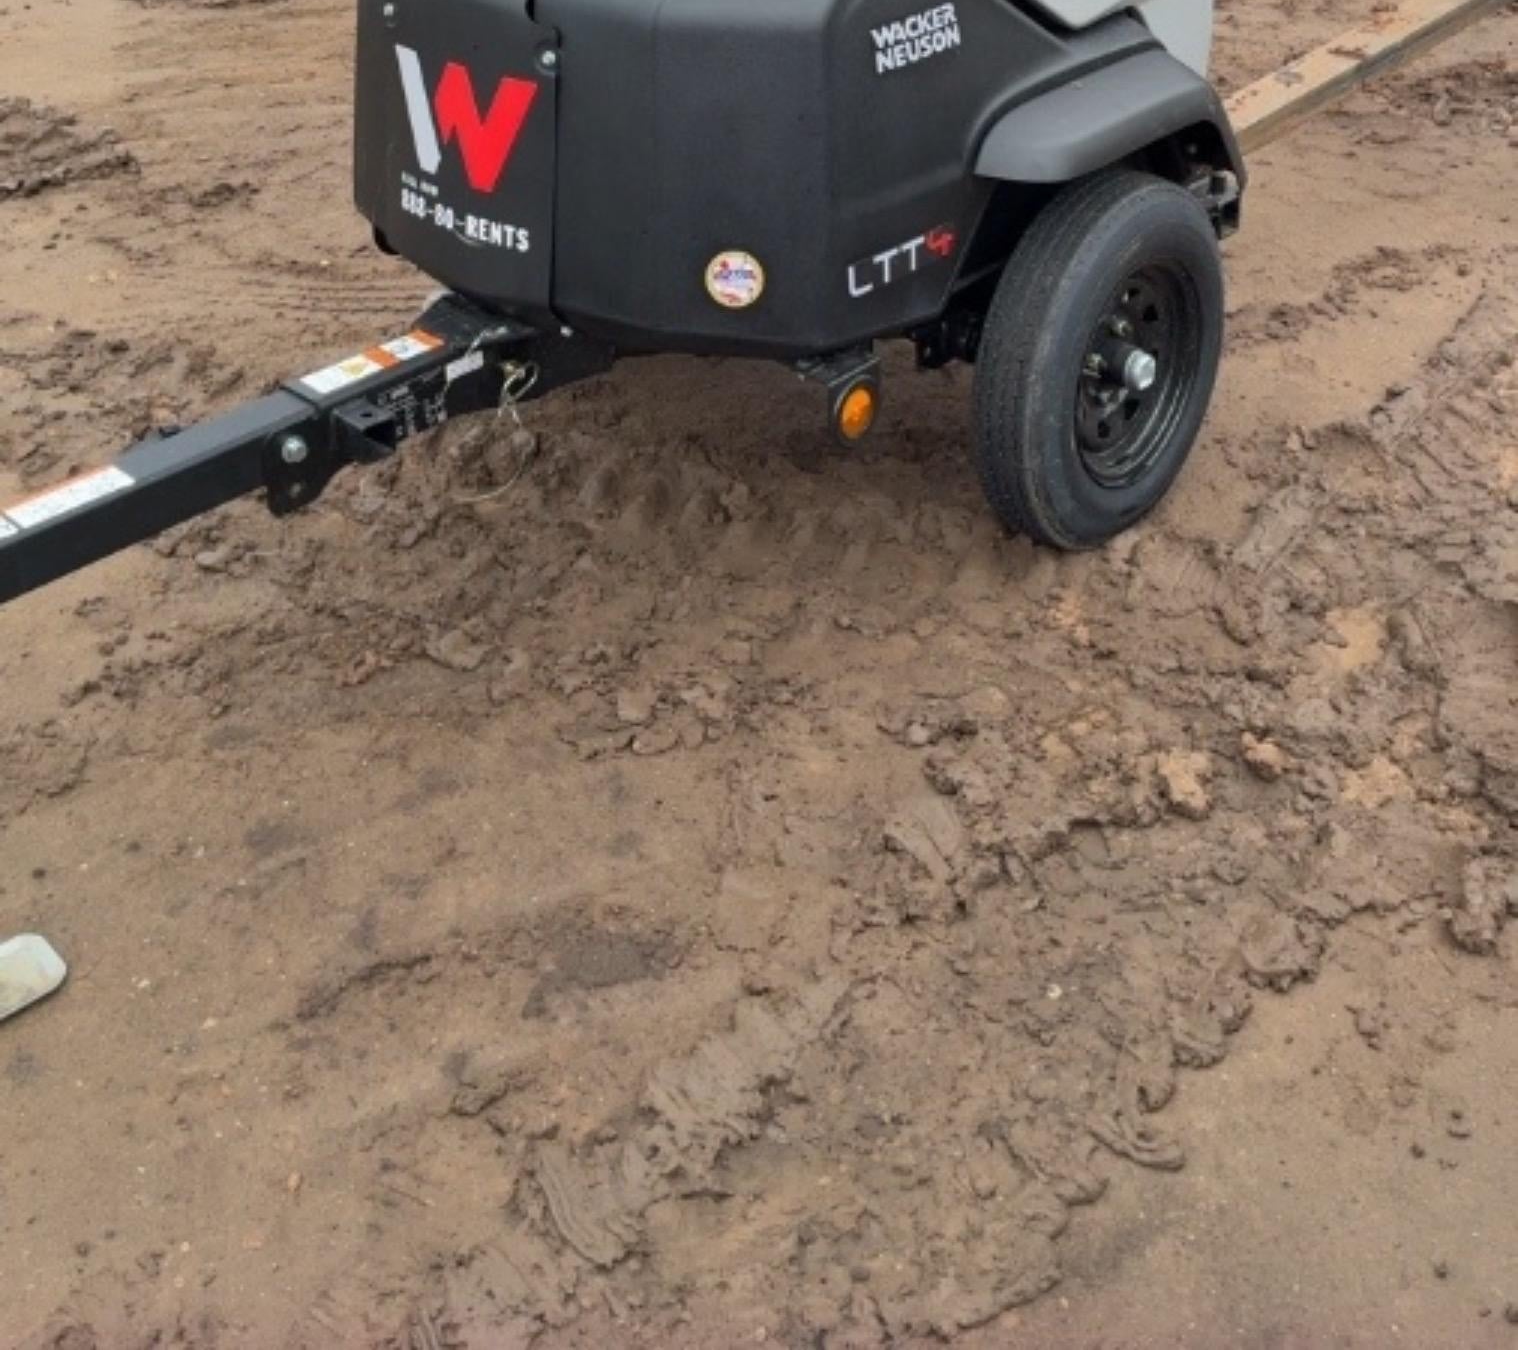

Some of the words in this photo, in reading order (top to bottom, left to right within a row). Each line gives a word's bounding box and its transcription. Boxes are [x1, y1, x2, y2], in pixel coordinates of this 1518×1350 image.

[870, 2, 958, 50] WACKER
[876, 23, 961, 74] NEUSON
[847, 227, 955, 298] LTT4
